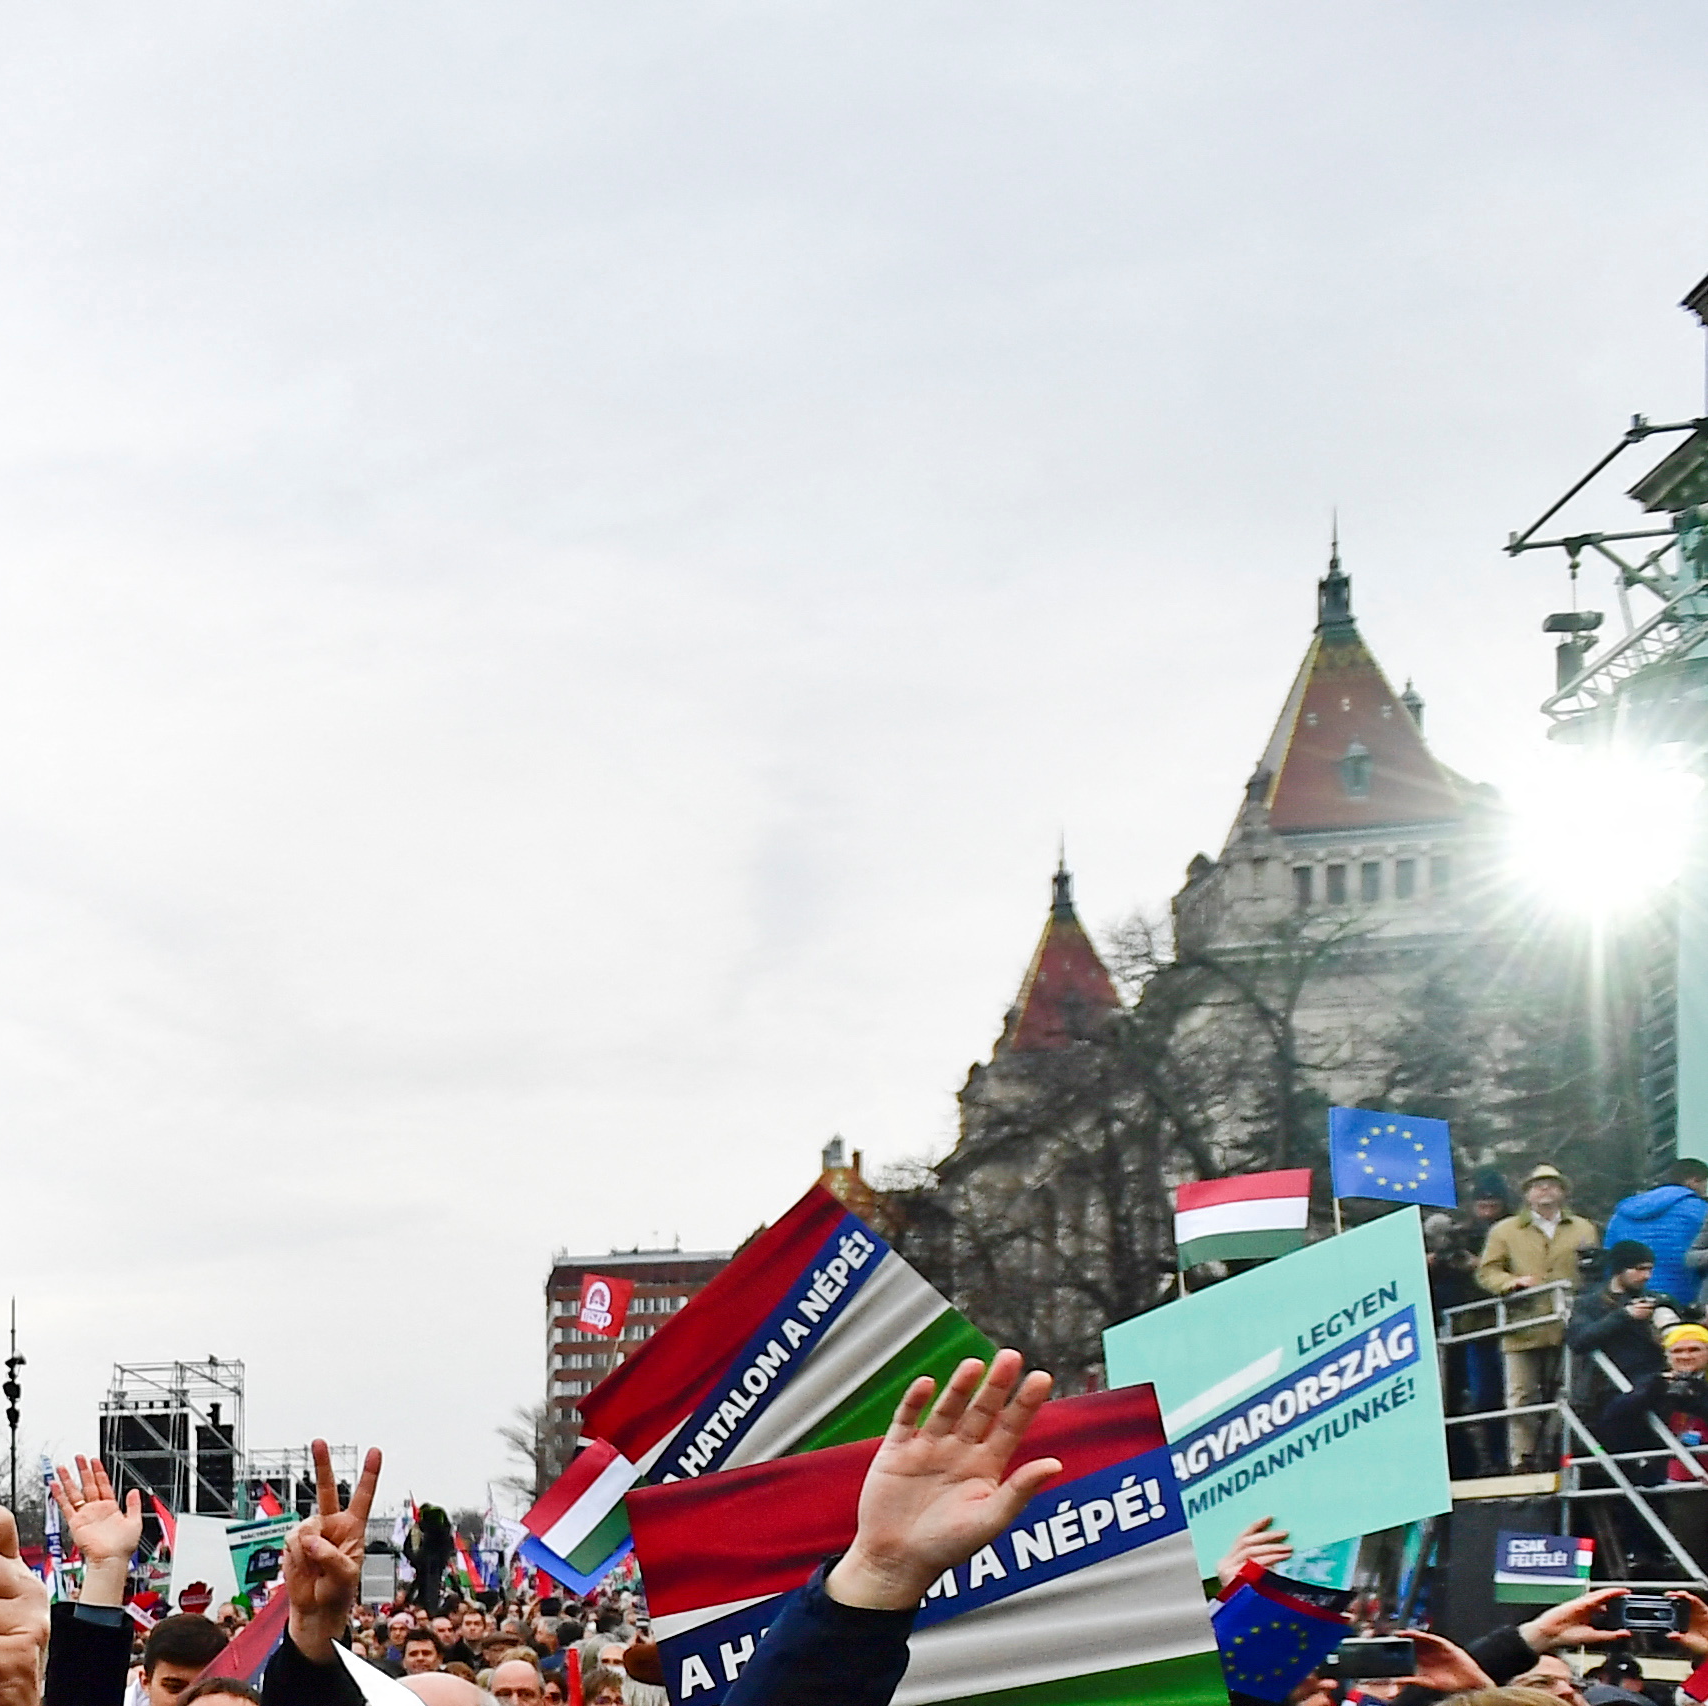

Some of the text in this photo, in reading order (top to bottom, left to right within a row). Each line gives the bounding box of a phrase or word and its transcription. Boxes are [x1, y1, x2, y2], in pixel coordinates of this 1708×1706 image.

[678, 1230, 876, 1478] HATALOM A NÉPÉ!
[1297, 1280, 1399, 1357] LEGYEN
[1170, 1321, 1415, 1482] AGYARORSZÁG
[1188, 1375, 1417, 1520] MINDANNYIUNKÉ!
[969, 1543, 1008, 1590] A
[1009, 1473, 1168, 1571] NÉPÉ!
[1505, 1550, 1569, 1568] FELFELÉ!
[1507, 1538, 1548, 1553] CSAK
[680, 1655, 716, 1699] A
